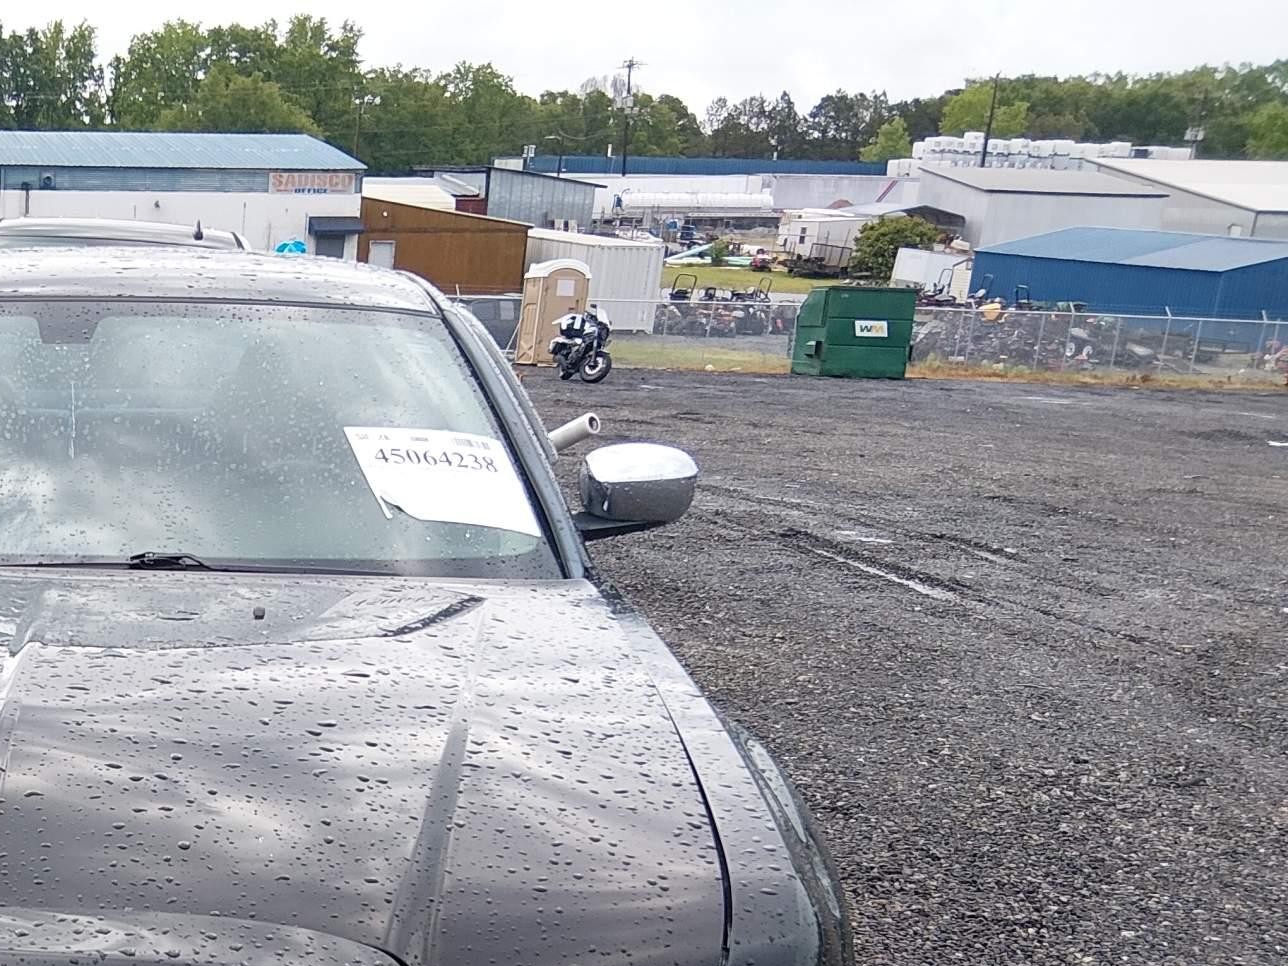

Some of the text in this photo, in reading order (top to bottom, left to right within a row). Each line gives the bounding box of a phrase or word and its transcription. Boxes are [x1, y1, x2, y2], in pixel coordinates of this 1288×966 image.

[273, 174, 355, 187] SADISCO
[859, 324, 884, 333] WM
[375, 448, 499, 473] 45064238
